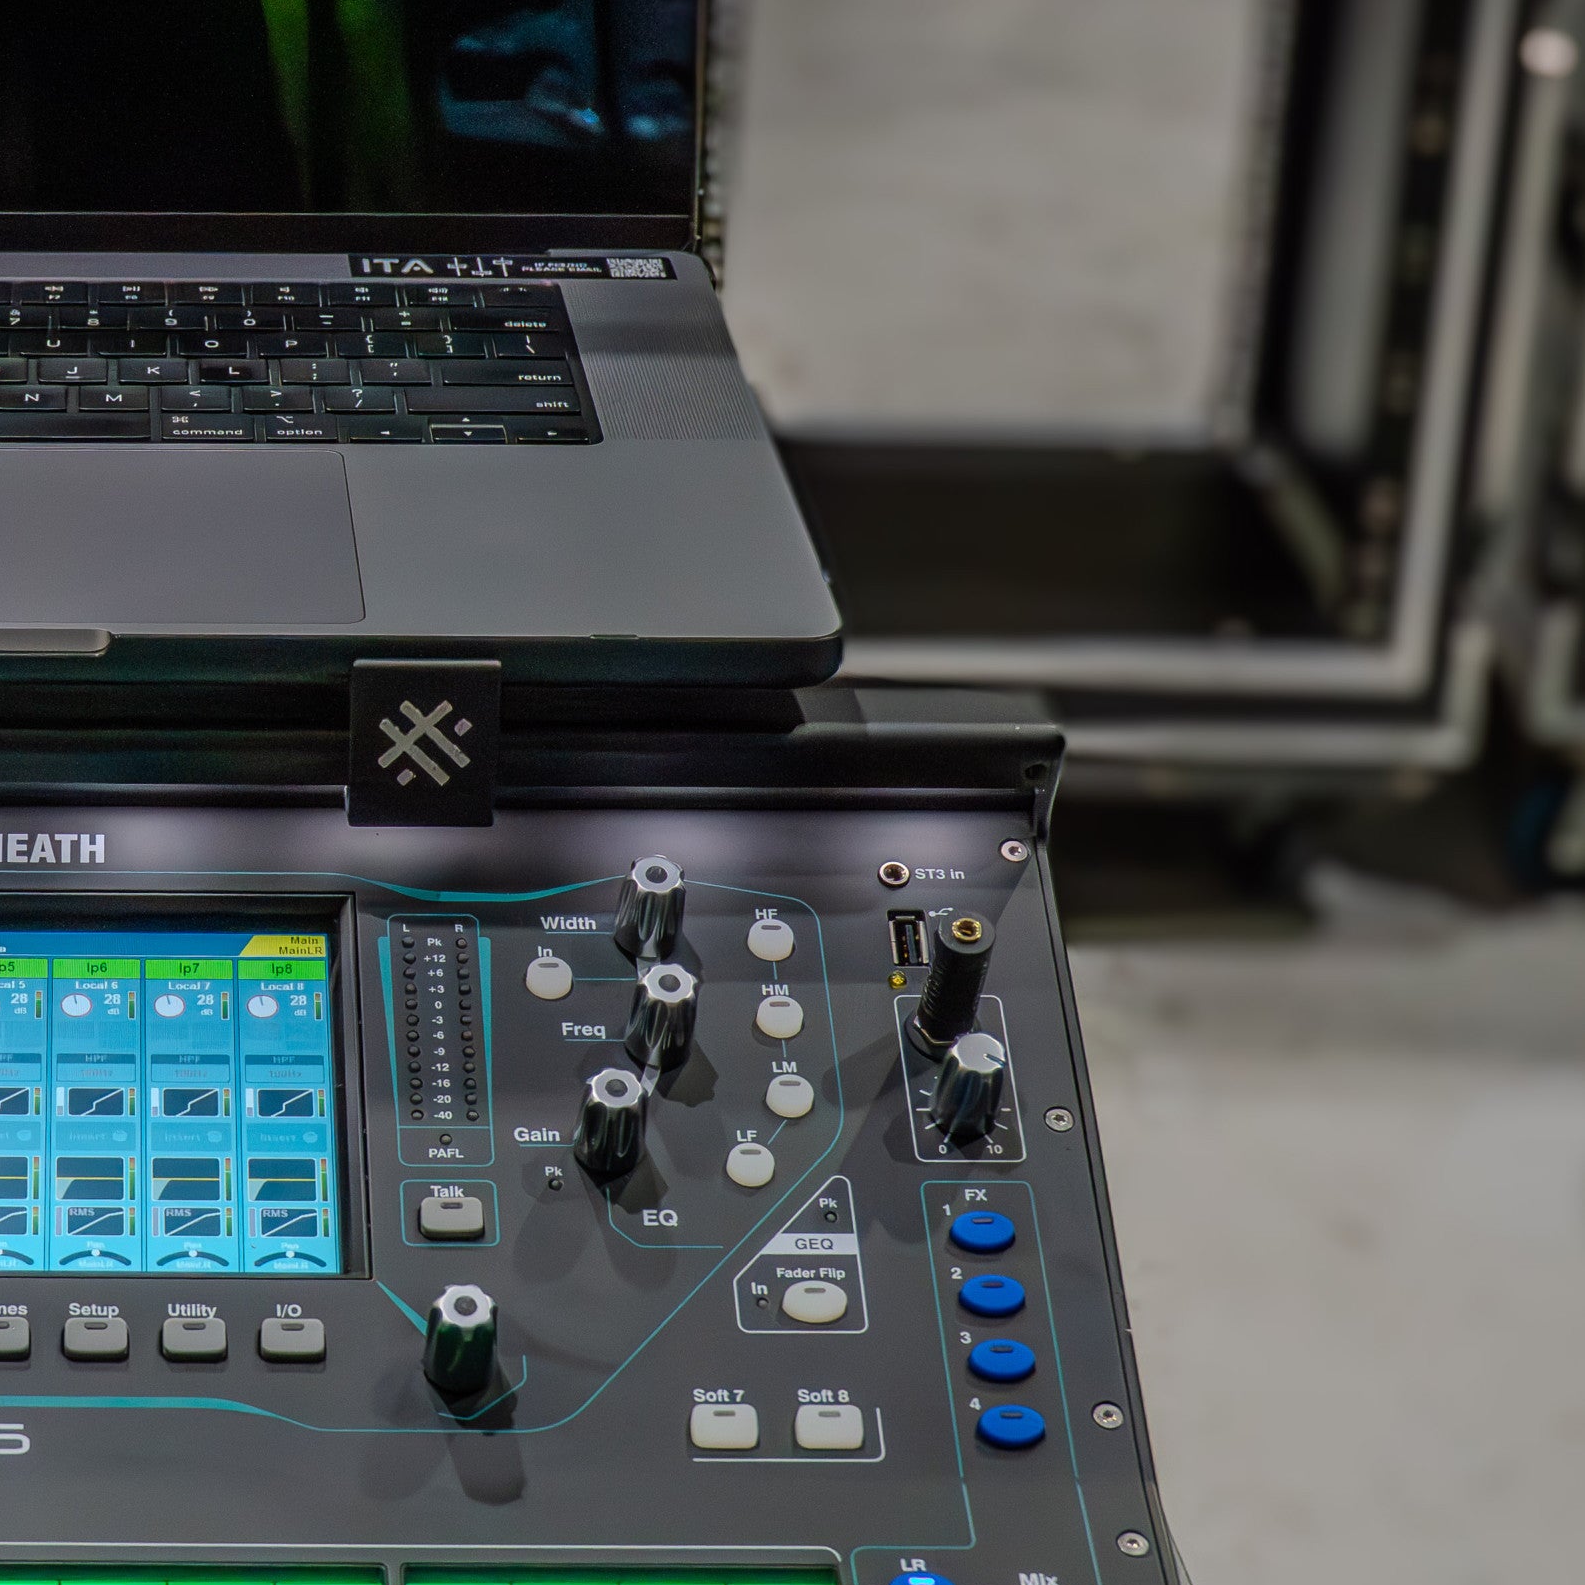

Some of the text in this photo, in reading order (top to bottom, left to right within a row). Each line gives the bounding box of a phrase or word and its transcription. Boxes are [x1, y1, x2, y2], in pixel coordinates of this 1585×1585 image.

[362, 258, 433, 273] ITA
[518, 374, 561, 382] return
[536, 400, 570, 408] shift
[277, 429, 323, 437] option
[915, 868, 965, 879] ST3 in
[755, 908, 778, 921] HF
[403, 924, 411, 933] L
[454, 924, 464, 933] R
[540, 916, 597, 930] Width
[290, 936, 319, 944] Main
[428, 937, 442, 946] Pk
[278, 946, 323, 955] MainLR
[537, 946, 553, 957] In
[423, 954, 447, 963] +12
[427, 968, 444, 977] +6
[428, 984, 445, 994] +3
[762, 984, 790, 997] HM
[434, 1000, 442, 1010] 0
[431, 1015, 444, 1025] -3
[432, 1030, 445, 1040] -6
[561, 1022, 607, 1040] Freq
[433, 1047, 446, 1056] -9
[431, 1063, 450, 1072] -12
[771, 1061, 798, 1073] LM
[432, 1079, 451, 1088] -16
[432, 1094, 452, 1104] -20
[433, 1110, 453, 1120] -40
[514, 1127, 561, 1143] Gain
[736, 1130, 758, 1143] LF
[428, 1148, 464, 1158] PAFL
[938, 1144, 947, 1154] 0
[985, 1144, 1003, 1154] 10
[545, 1166, 563, 1177] Pk
[430, 1185, 465, 1198] Talk
[965, 1189, 987, 1201] FX
[819, 1197, 837, 1208] Pk
[943, 1205, 951, 1215] 1
[642, 1210, 679, 1227] EQ
[794, 1238, 834, 1251] GEQ
[776, 1268, 846, 1280] Fader Flip
[951, 1268, 962, 1279] 2
[751, 1282, 768, 1295] In
[69, 1303, 119, 1319] Setup
[167, 1303, 217, 1318] Utility
[275, 1303, 302, 1317] I/O
[960, 1332, 971, 1344] 3
[693, 1389, 745, 1402] Soft 7
[798, 1390, 849, 1403] Soft 8
[969, 1398, 981, 1410] 4
[901, 1558, 926, 1571] LR
